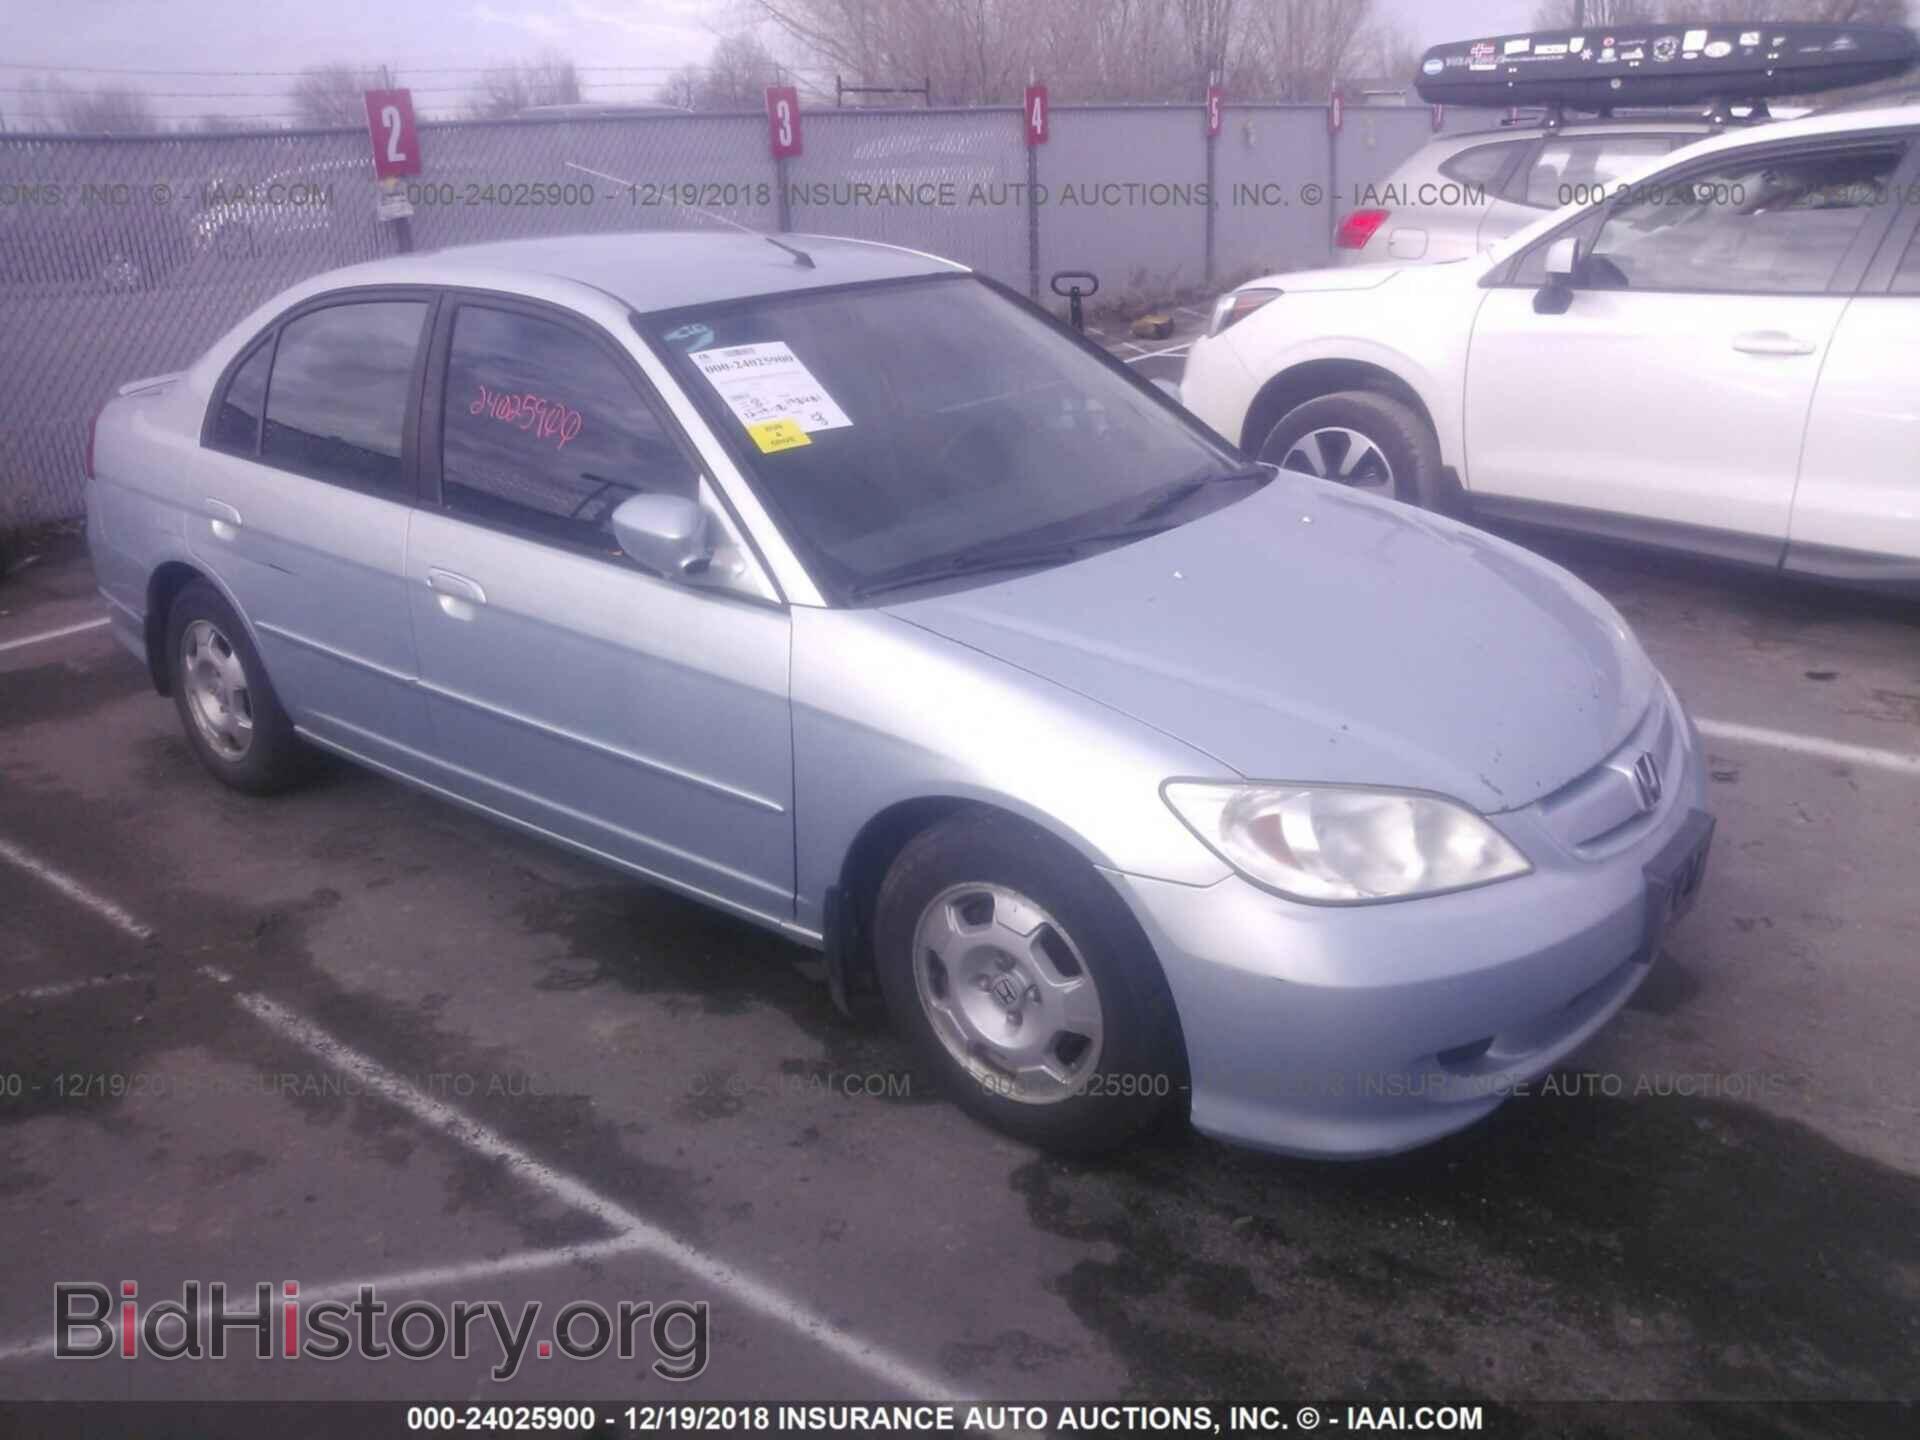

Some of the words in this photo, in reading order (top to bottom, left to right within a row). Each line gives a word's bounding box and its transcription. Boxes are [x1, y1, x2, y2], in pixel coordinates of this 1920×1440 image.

[381, 105, 407, 163] 2
[776, 99, 793, 148] 3
[1030, 96, 1042, 136] 4
